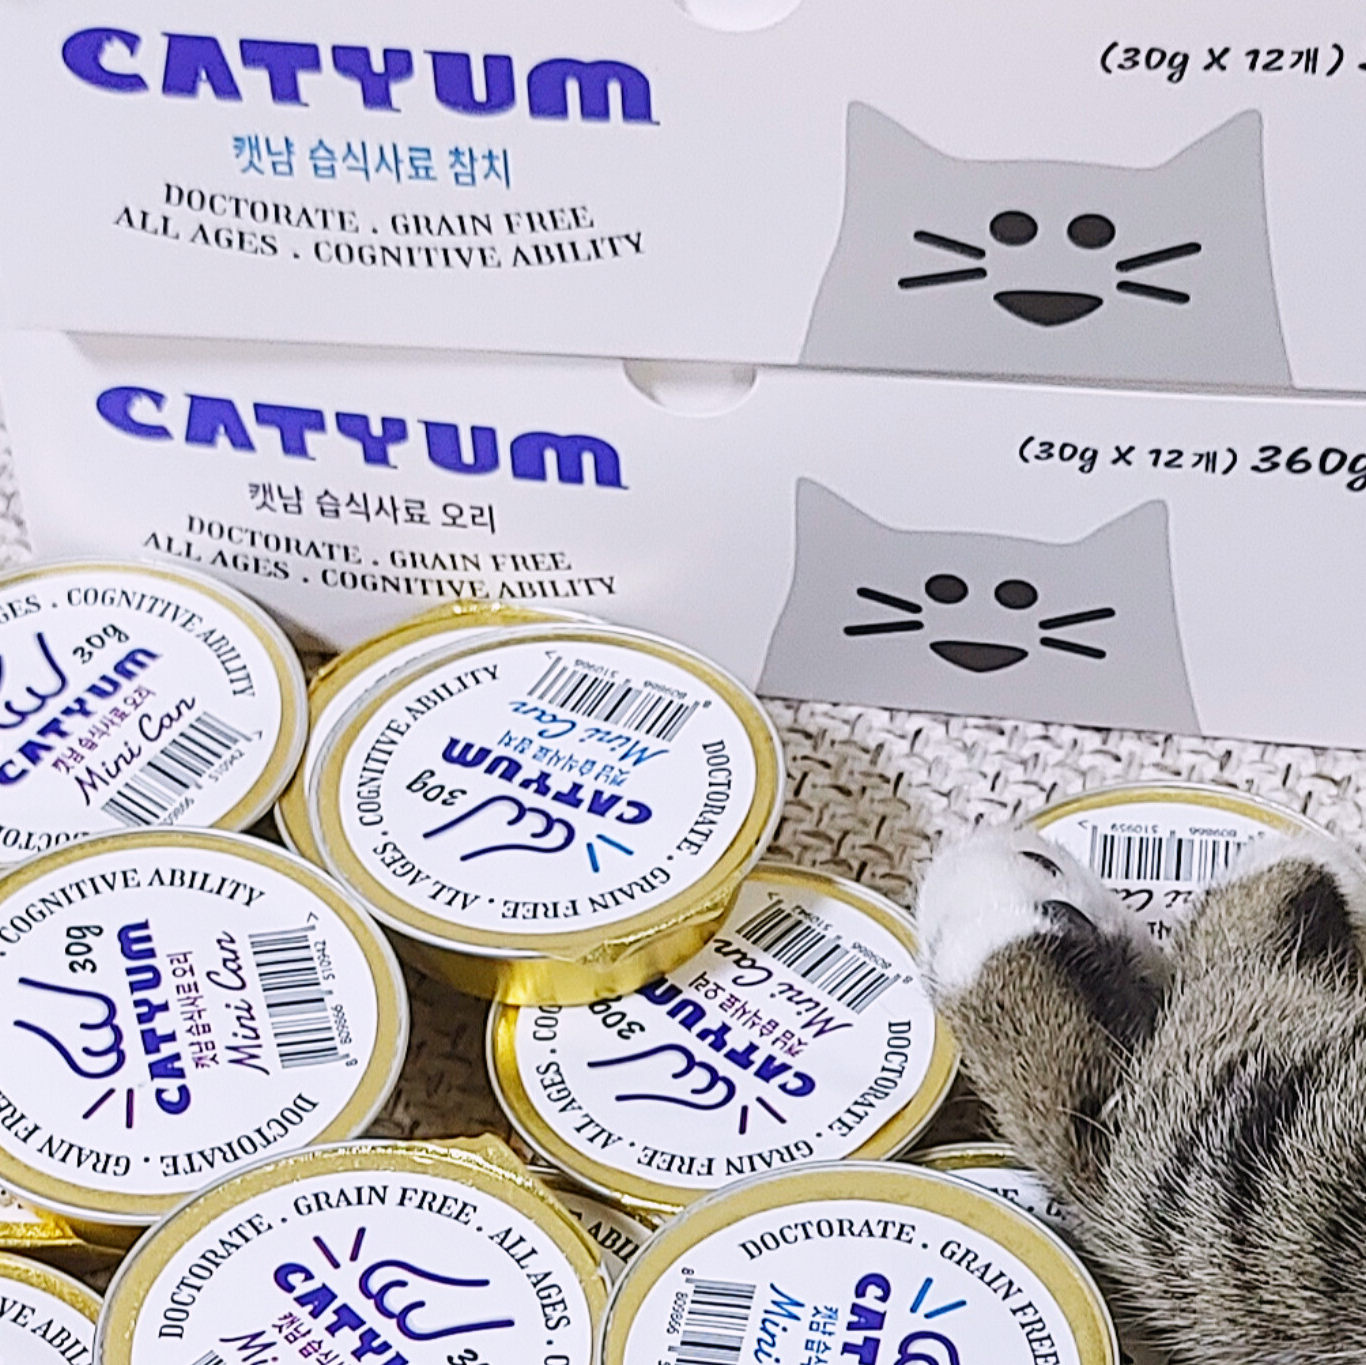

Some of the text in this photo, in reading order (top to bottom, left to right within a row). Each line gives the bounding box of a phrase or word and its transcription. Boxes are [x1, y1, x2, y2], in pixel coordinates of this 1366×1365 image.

[62, 27, 661, 127] CATYUM
[1099, 41, 1191, 84] (30g
[308, 138, 437, 184] 습식사료
[449, 145, 511, 190] 참치
[112, 206, 645, 270] ALL AGES COGNITIVE ABILITY
[164, 183, 595, 238] DOCTORATE GRAIN FREE
[95, 385, 630, 491] CATYUM
[1019, 436, 1099, 474] (30g
[187, 515, 572, 571] DOCTORATE GRAIN FREE
[315, 489, 498, 535] 습식사료 오리
[142, 531, 618, 599] ALL AGES COGNITIVE ABILITY
[66, 587, 256, 698] COGNITIVE ABILITY
[73, 622, 130, 665] 30g
[74, 694, 197, 806] Mini Can
[357, 664, 500, 827] COGNITIVE ABILITY
[509, 701, 671, 768] Mini Can
[406, 769, 468, 807] 30g
[442, 736, 653, 826] CATYUM
[677, 738, 733, 856] DOCTORATE
[146, 867, 266, 909] ABILITY
[372, 841, 481, 911] ALL AGES
[502, 866, 672, 920] GRAIN FREE
[64, 924, 105, 974] 30g
[166, 950, 196, 980] 오리
[116, 918, 192, 1115] CATYUM
[206, 930, 270, 1075] Mini Can
[688, 970, 728, 1001] 오리
[713, 938, 855, 1039] Mini Can
[636, 977, 816, 1097] CATYUM
[534, 1061, 624, 1150] ALL AGES
[829, 1019, 912, 1138] DOCTORATE
[40, 1135, 131, 1177] GRAIN
[161, 1091, 319, 1177] DOCTORATE
[637, 1139, 814, 1177] GRAIN FREE
[293, 1185, 478, 1226] GRAIN FREE
[738, 1218, 917, 1262] DOCTORATE
[938, 1239, 1024, 1302] GRAIN
[157, 1213, 272, 1341] DOCTORATE
[488, 1226, 572, 1332] ALL AGES
